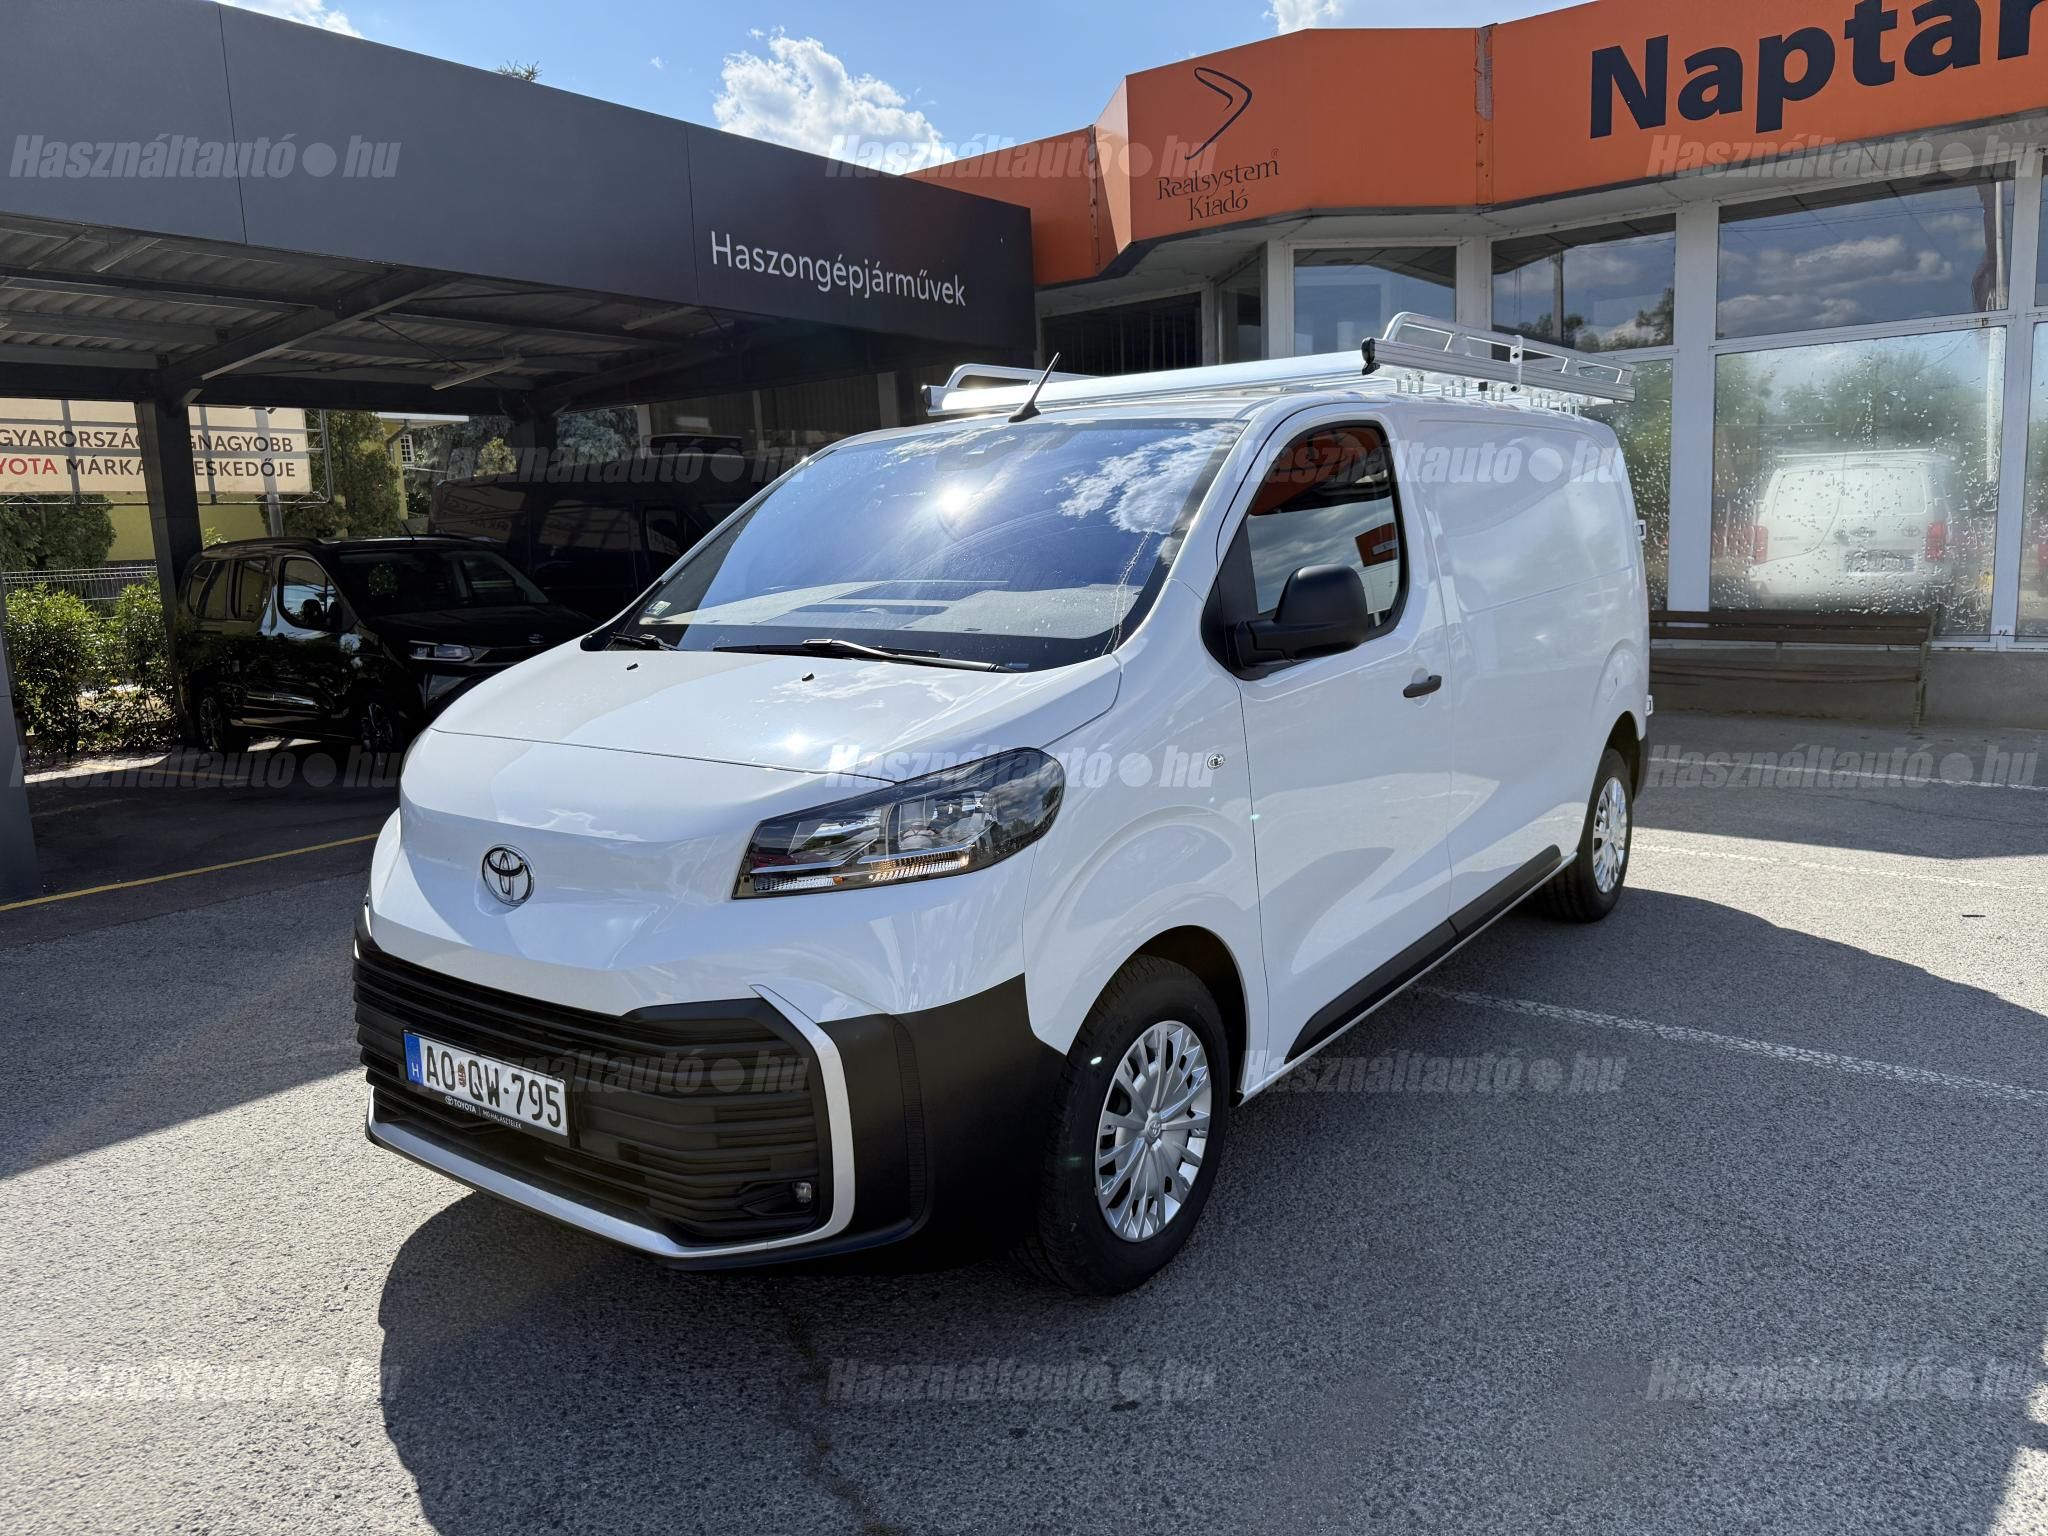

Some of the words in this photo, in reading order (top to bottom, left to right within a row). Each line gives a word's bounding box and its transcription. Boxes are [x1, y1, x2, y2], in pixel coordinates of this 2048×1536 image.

[1187, 189, 1249, 221] Kiadó
[711, 231, 966, 306] Haszongépjárművek
[0, 428, 141, 448] GYARORSZÁ
[411, 1062, 420, 1078] H
[453, 1099, 477, 1114] TOYOTA
